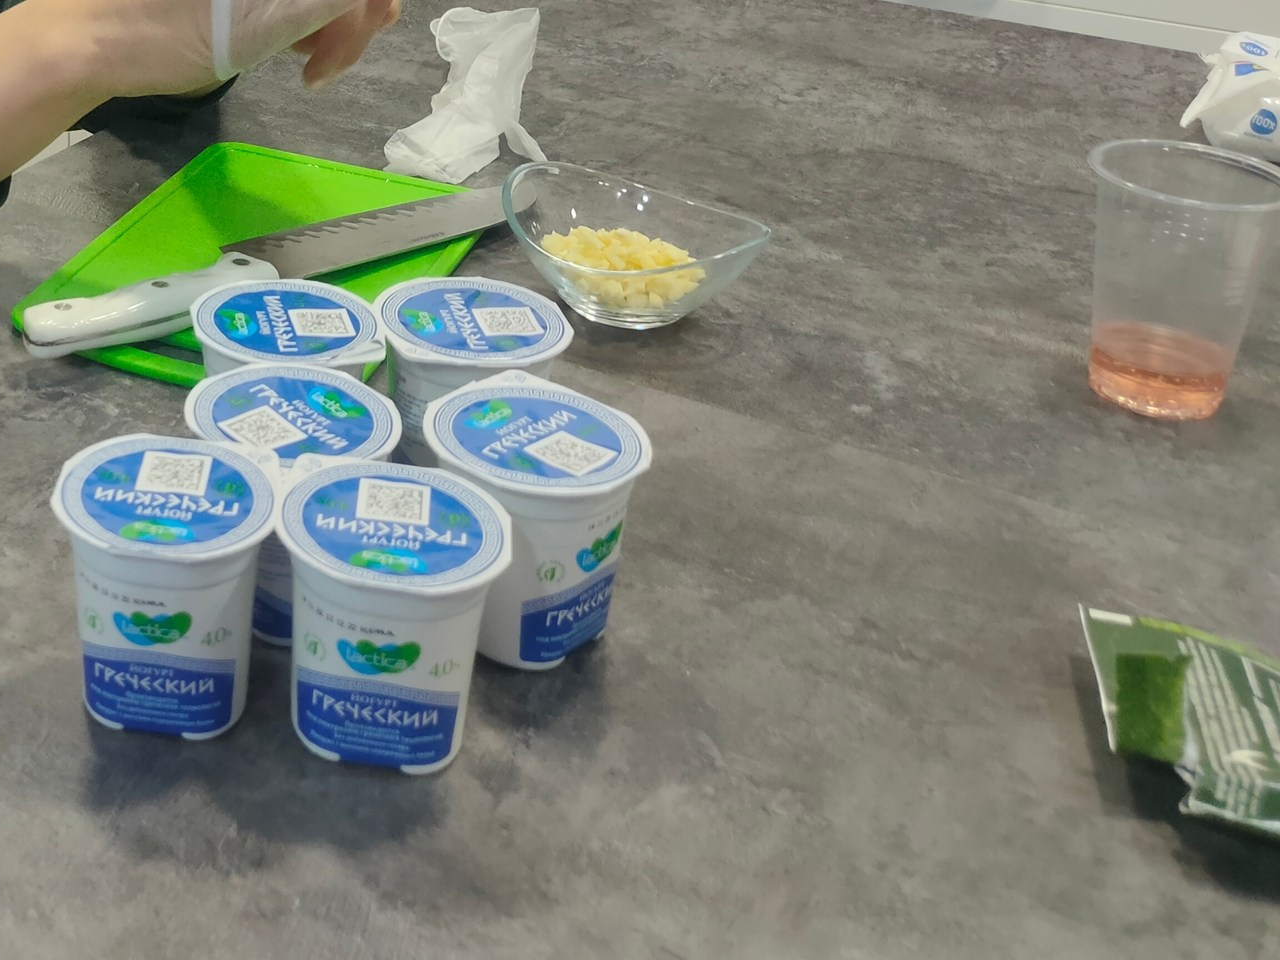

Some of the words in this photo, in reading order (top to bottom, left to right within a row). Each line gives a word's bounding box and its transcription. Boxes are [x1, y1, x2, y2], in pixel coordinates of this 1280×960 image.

[263, 295, 298, 353] ГРЕЧЕСКИЙ
[443, 292, 489, 351] ГРЕЧЕСКИЙ
[248, 383, 350, 450] ГРЕЧЕСКИЙ
[292, 398, 333, 426] ЙОГУРТ
[480, 408, 580, 460] ГРЕЧЕСКИЙ
[94, 486, 240, 517] ГРЕЧЕСКИЙ
[135, 505, 193, 521] ЙОГУРТ
[315, 513, 469, 547] ГРЕЧЕСКИЙ
[361, 535, 421, 551] ЙОГУРТ
[121, 618, 180, 640] lactica
[345, 646, 408, 668] lactica
[94, 661, 216, 696] ГРЕЧЕСКИЙ
[311, 687, 439, 729] ГРЕЧЕСКИЙ
[350, 692, 398, 707] ЙОГУРТ
